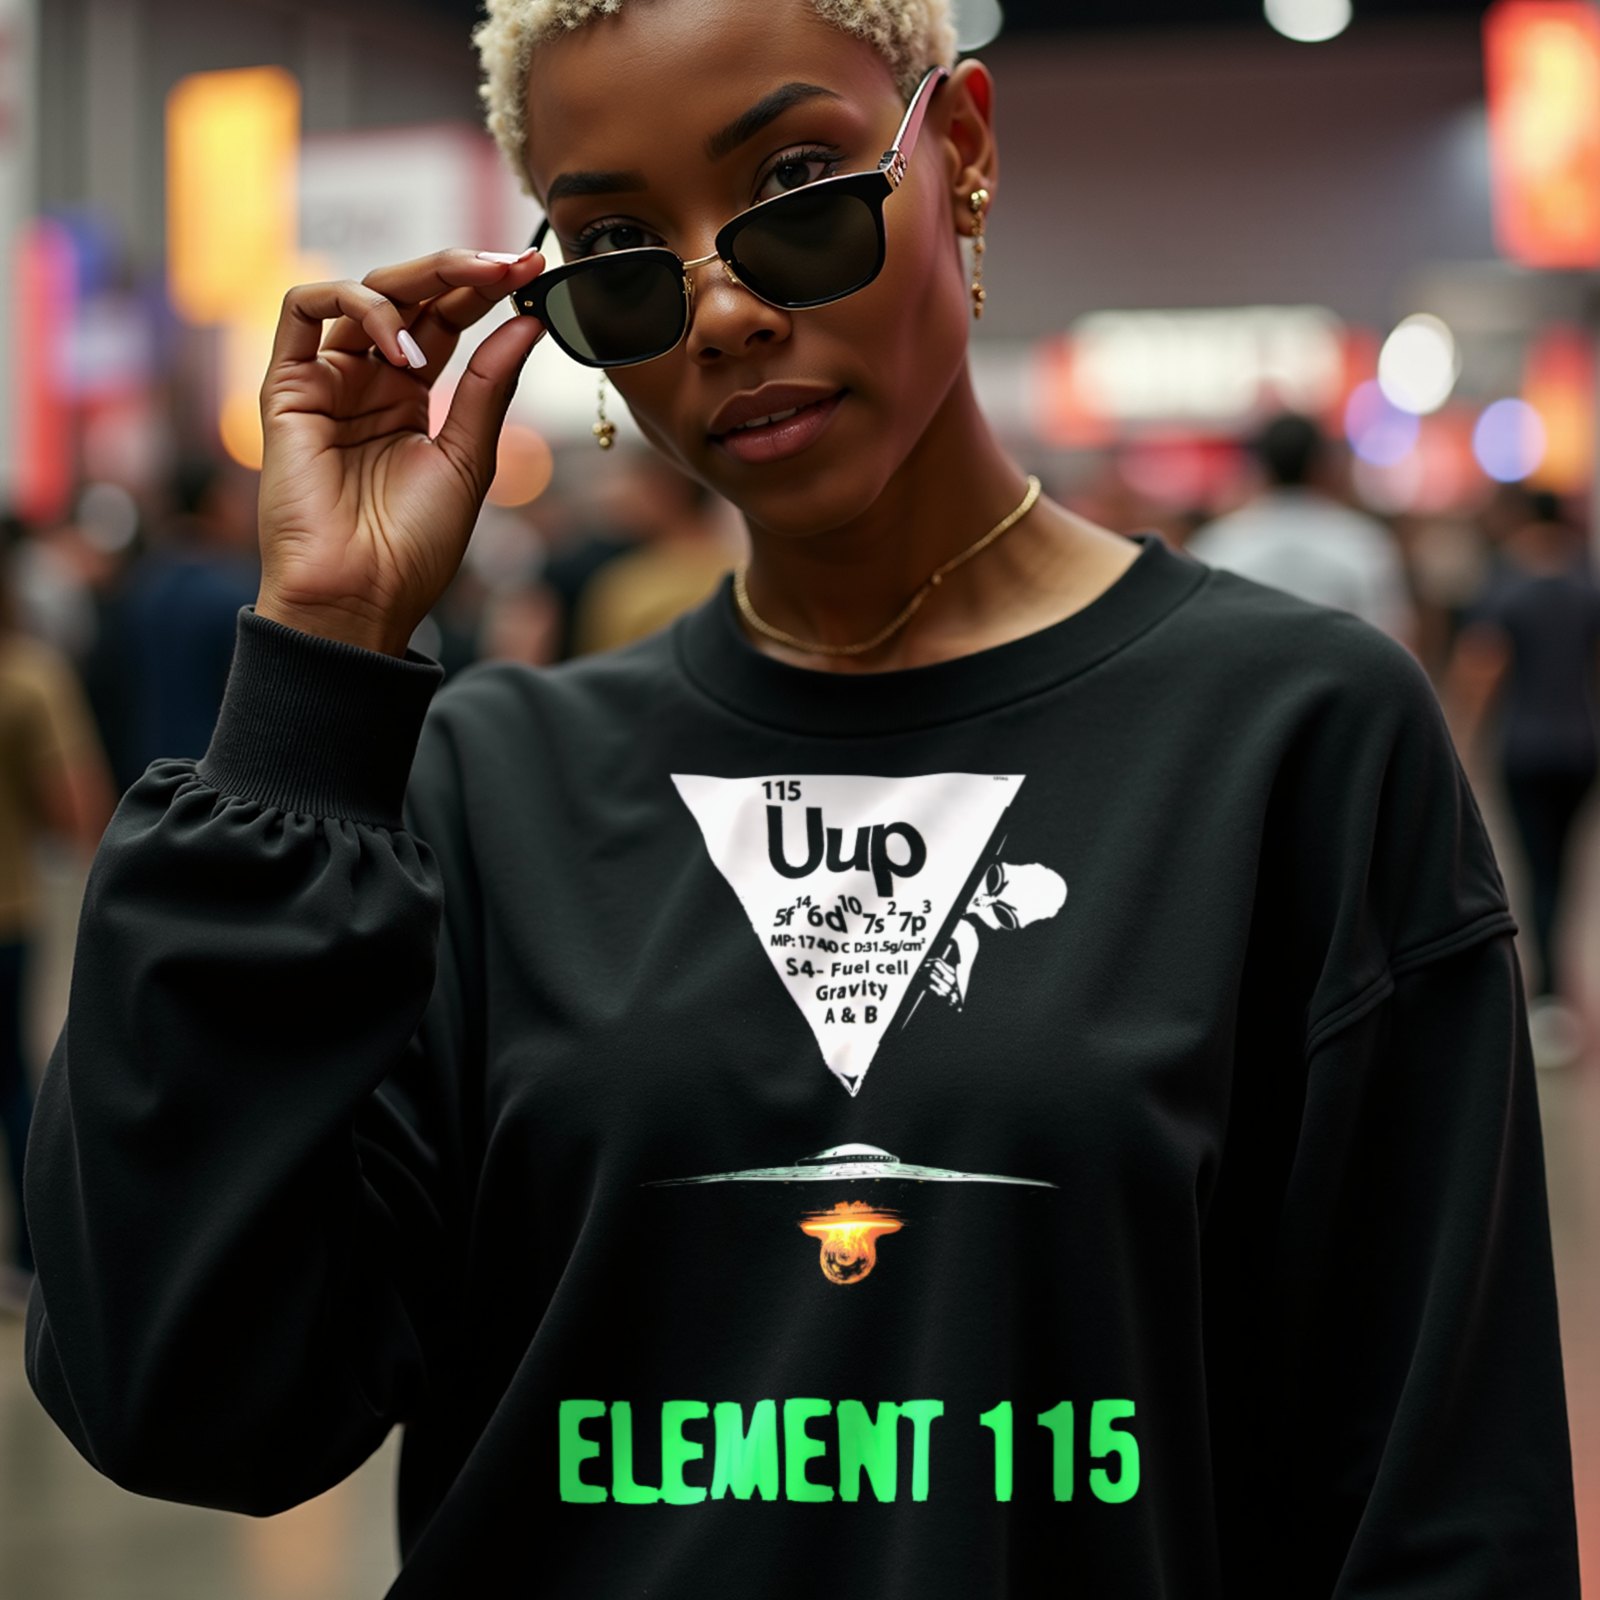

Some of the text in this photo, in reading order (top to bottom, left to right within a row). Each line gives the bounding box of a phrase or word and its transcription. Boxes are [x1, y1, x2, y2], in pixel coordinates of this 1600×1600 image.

[762, 781, 801, 801] 115
[767, 805, 927, 897] Uup
[831, 960, 869, 977] Fuel
[876, 960, 908, 975] cell
[816, 979, 888, 1001] Gravity
[825, 1005, 877, 1024] A & B
[559, 1398, 1140, 1504] ELEMENT 115
